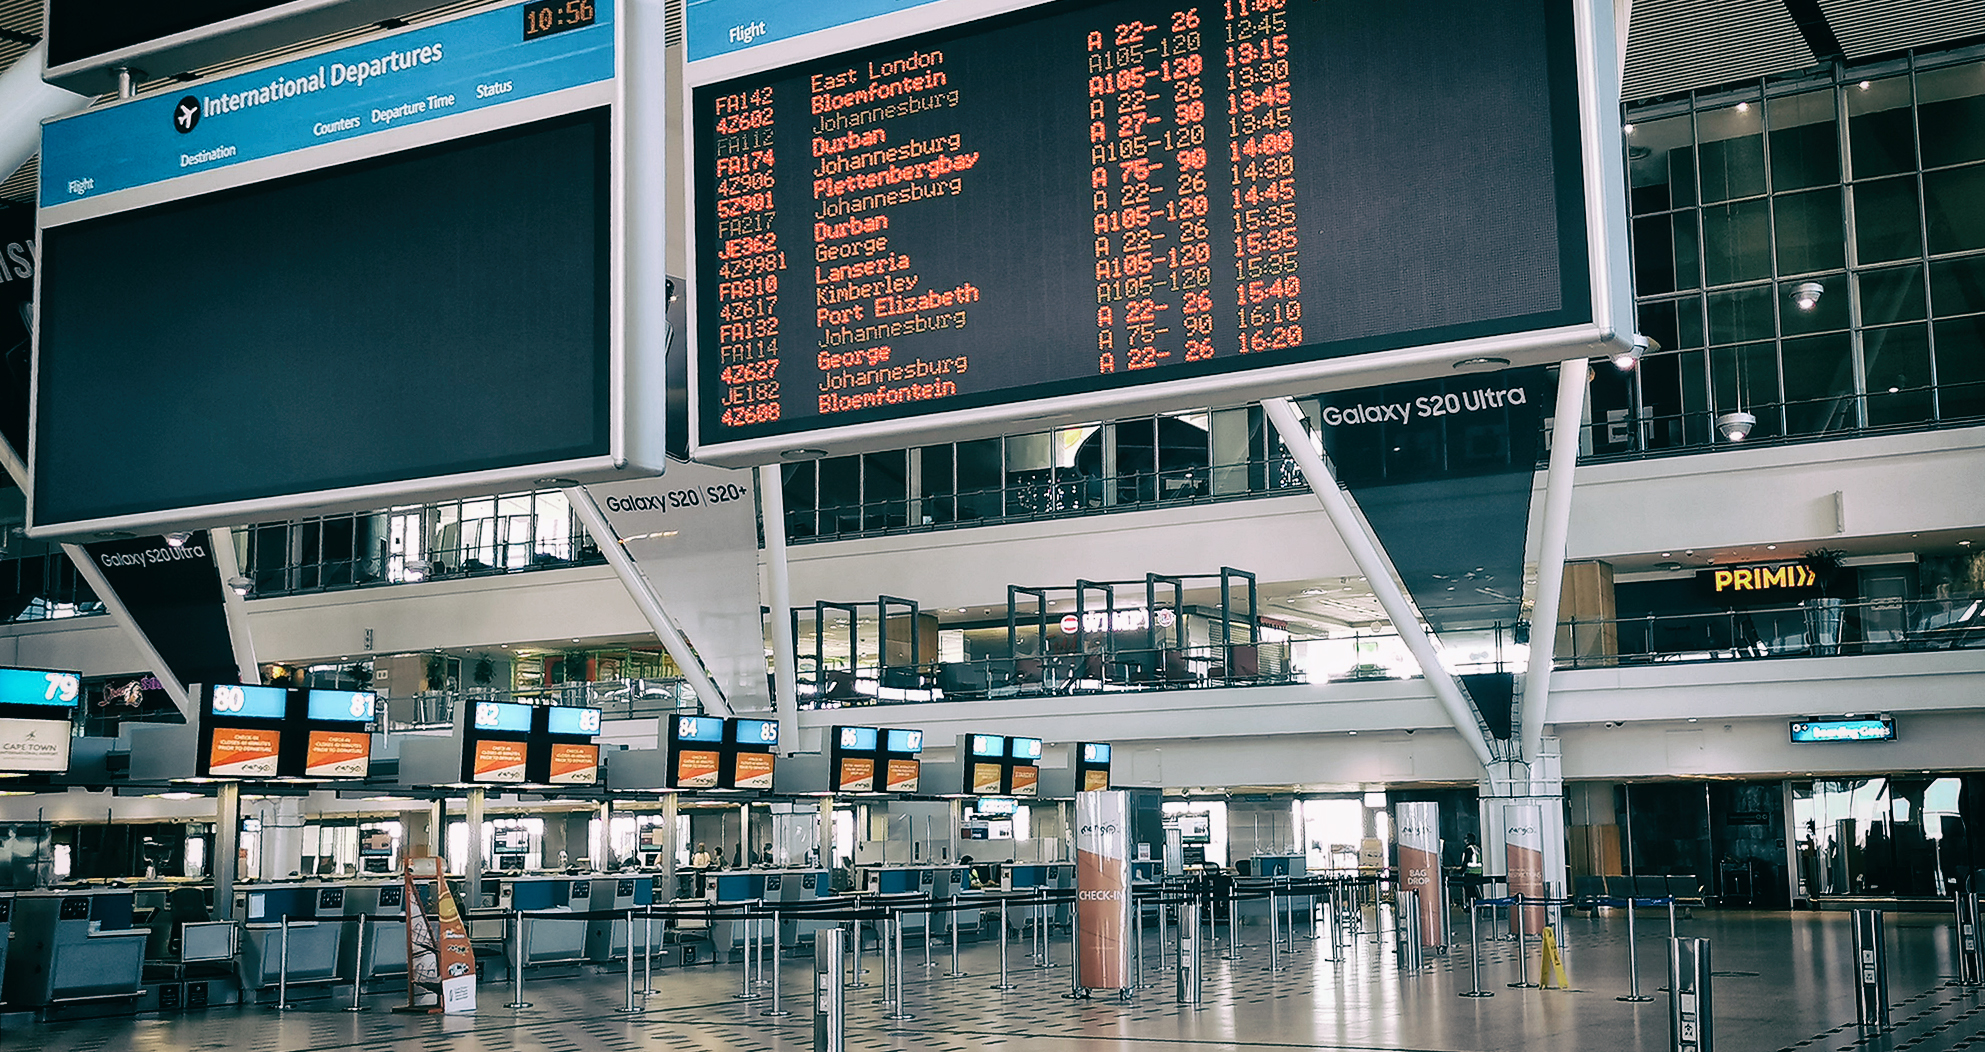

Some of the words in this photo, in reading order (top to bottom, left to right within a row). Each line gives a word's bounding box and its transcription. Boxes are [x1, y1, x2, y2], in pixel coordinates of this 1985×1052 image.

[527, 0, 593, 34] 10:56
[729, 20, 767, 43] Flight
[203, 67, 326, 118] International
[331, 42, 443, 87] Departures
[716, 107, 774, 134] 4Z602
[811, 70, 946, 115] Bloemfontein
[1088, 31, 1102, 51] A
[1171, 8, 1200, 32] 26
[716, 87, 773, 115] FA142
[811, 69, 857, 93] East
[869, 51, 943, 79] London
[813, 90, 958, 134] Johannesburg
[1089, 31, 1200, 73] A105-120
[1226, 11, 1286, 42] 12:45
[476, 80, 513, 99] Status
[371, 100, 426, 124] Departure
[426, 94, 455, 111] Time
[717, 149, 775, 177] FA174
[812, 128, 886, 157] Durban
[1089, 54, 1203, 97] A105-120
[1226, 34, 1289, 68] 13:15
[313, 116, 361, 136] Counters
[718, 169, 775, 197] 4Z906
[813, 134, 960, 177] Johannesburg
[1090, 99, 1104, 119] A
[1174, 77, 1203, 102] 26
[1227, 59, 1289, 90] 13:30
[180, 145, 237, 167] Destination
[717, 191, 774, 218] 5Z901
[814, 152, 979, 199] Plettenbergbay
[1090, 121, 1106, 143] A
[1175, 100, 1204, 125] 30
[1228, 82, 1291, 115] 13:45
[68, 178, 94, 194] Flight
[719, 211, 775, 238] FA217
[815, 176, 961, 219] Johannesburg
[1092, 124, 1204, 165] A105-120
[1229, 106, 1291, 137] 13:45
[718, 232, 777, 260] JE362
[814, 215, 889, 242] Durban
[1092, 167, 1107, 189] A
[1176, 147, 1207, 172] 90
[1229, 130, 1294, 162] 14:00
[719, 251, 787, 279] 4Z9981
[815, 237, 888, 262] George
[1094, 190, 1108, 211] A
[1178, 171, 1207, 195] 26
[1231, 155, 1294, 185] 14:30
[719, 274, 777, 301] FA310
[815, 252, 910, 284] Lanseria
[1094, 194, 1208, 235] A105-120
[1232, 178, 1295, 210] 14:45
[720, 295, 777, 321] 4Z617
[816, 275, 918, 306] Kimberley
[1095, 237, 1109, 258] A
[1180, 219, 1209, 242] 26
[1233, 203, 1296, 233] 15:35
[720, 317, 779, 343] FA132
[817, 305, 864, 327] Port
[874, 283, 979, 318] Elizabeth
[1095, 242, 1210, 280] A105-120
[1234, 226, 1298, 257] 15:35
[721, 338, 778, 363] FA114
[819, 311, 966, 347] Johannesburg
[1097, 266, 1210, 303] A105-120
[1235, 251, 1298, 280] 15:35
[721, 359, 780, 384] 4Z627
[817, 346, 891, 370] George
[1097, 305, 1113, 327] A
[1183, 289, 1213, 314] 26
[1236, 275, 1301, 305] 15:40
[722, 381, 779, 406] JE182
[819, 356, 967, 391] Johannesburg
[1099, 328, 1113, 350] A
[1184, 313, 1213, 336] 90
[1238, 300, 1301, 328] 16:10
[721, 402, 780, 426] 4Z608
[819, 377, 956, 414] Bloemfontein
[1100, 352, 1115, 373] A
[1185, 337, 1215, 361] 26
[1238, 324, 1302, 353] 16:20
[1323, 403, 1411, 426] Galaxy
[1415, 393, 1461, 418] S20
[1462, 386, 1527, 412] Ultra
[607, 494, 666, 513] Galaxy
[668, 489, 700, 508] S20
[707, 483, 748, 504] S20+
[101, 552, 146, 568] Galaxy
[146, 547, 171, 564] S20
[171, 545, 206, 561] Ultra
[1715, 565, 1795, 592] PRIMI
[45, 673, 78, 702] 79
[213, 686, 245, 712] 80
[349, 692, 375, 718] 81
[476, 703, 499, 726] 82
[580, 709, 600, 731] 83
[679, 718, 698, 737] 84
[761, 722, 777, 741] 85
[907, 732, 921, 749] 87
[3, 743, 27, 751] CAPE
[28, 743, 57, 751] TOWN
[1407, 877, 1430, 885] DROP
[1409, 868, 1427, 877] BAG
[1079, 890, 1123, 901] CHECK-IN
